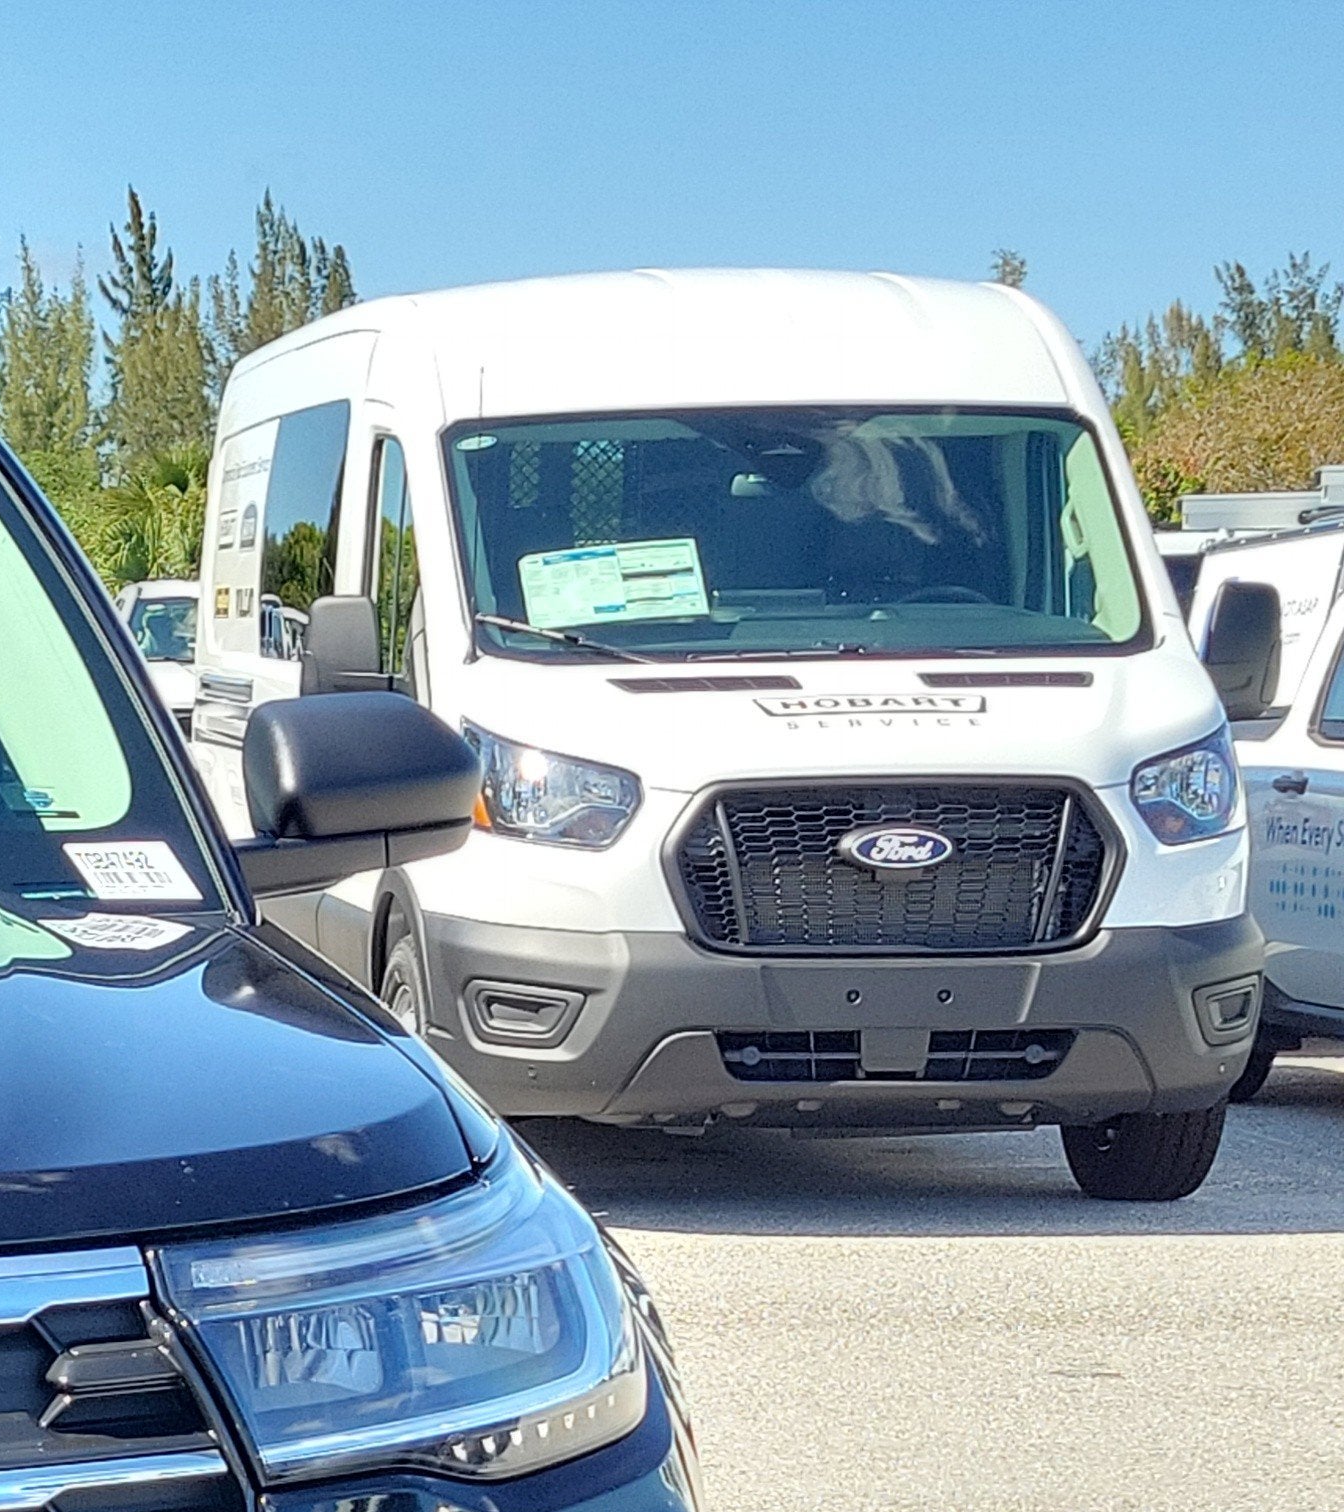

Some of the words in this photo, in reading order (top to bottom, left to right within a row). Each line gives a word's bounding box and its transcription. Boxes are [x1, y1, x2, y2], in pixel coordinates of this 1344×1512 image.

[780, 695, 967, 710] HOBART
[786, 717, 983, 730] SERVICE
[1302, 816, 1335, 856] Every
[869, 834, 934, 860] Ford
